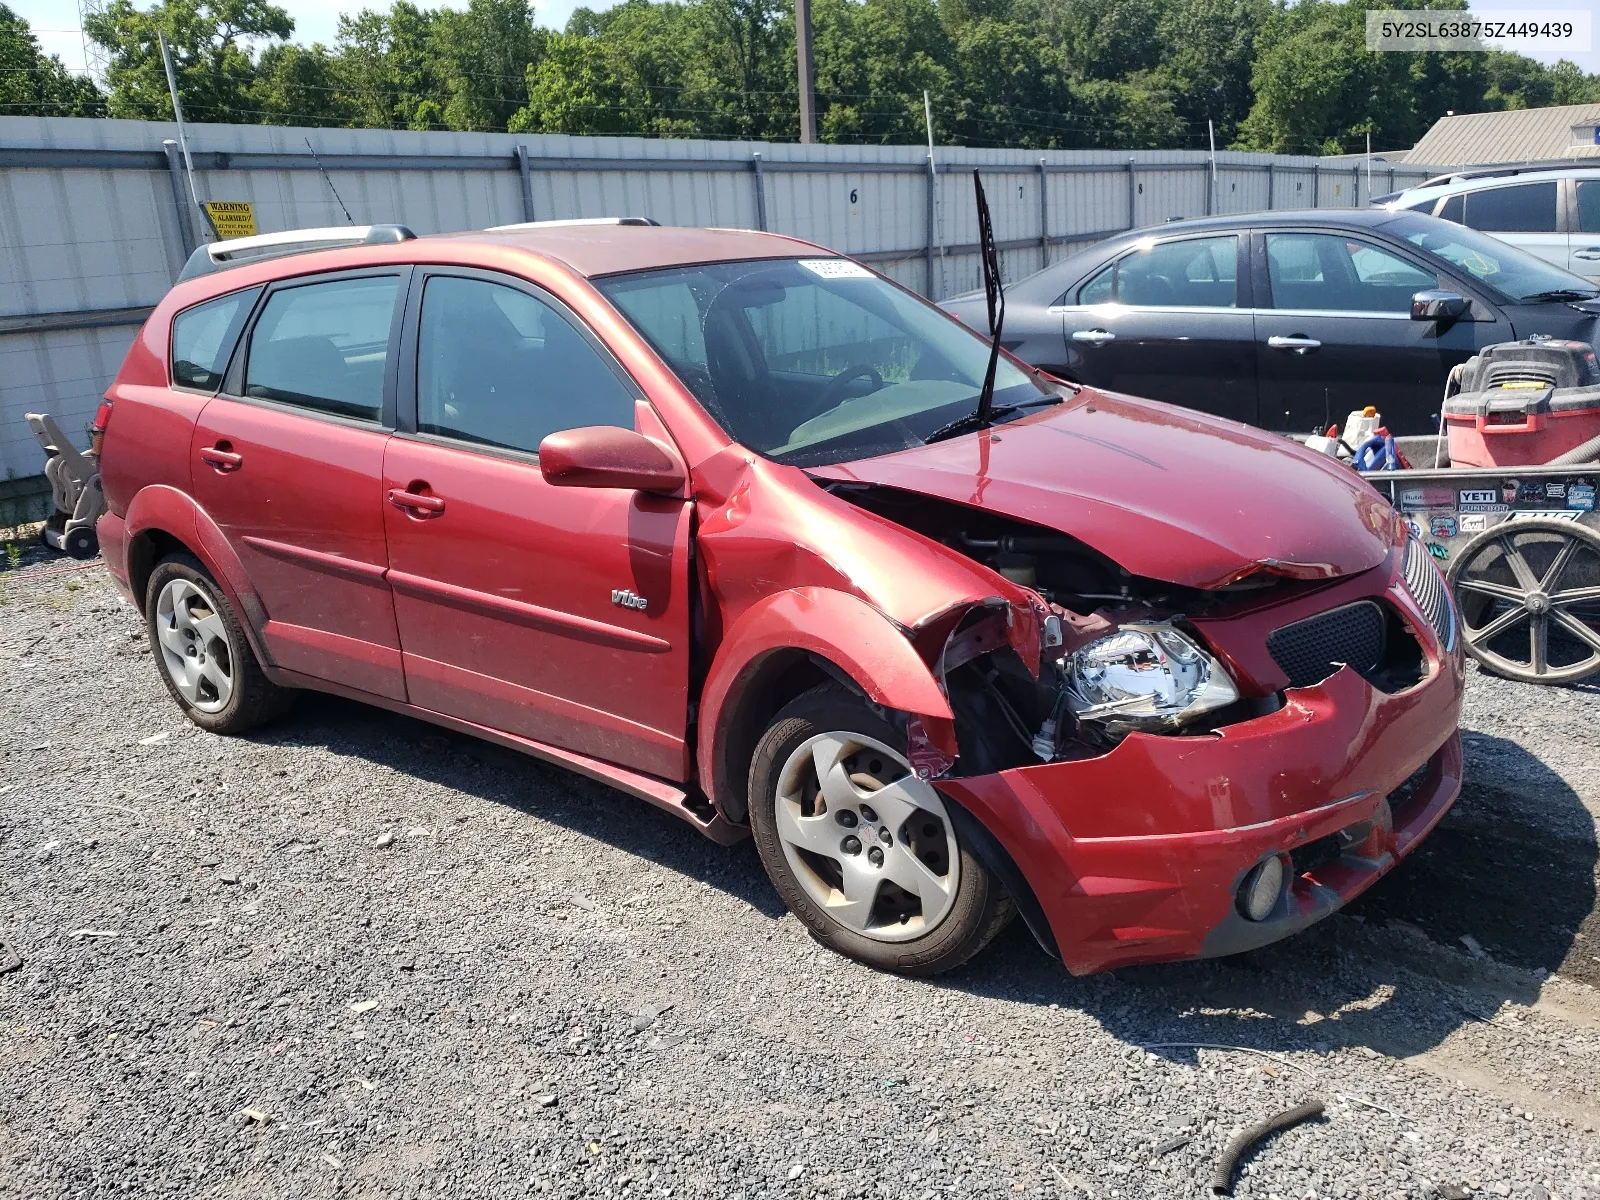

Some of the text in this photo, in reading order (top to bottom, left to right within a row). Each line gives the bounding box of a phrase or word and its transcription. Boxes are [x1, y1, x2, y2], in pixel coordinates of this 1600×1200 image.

[1018, 186, 1024, 200] 7
[1138, 183, 1143, 195] 8
[850, 188, 858, 204] 6
[210, 203, 250, 211] WARNING
[1462, 492, 1493, 501] YETI
[611, 589, 648, 610] vibe
